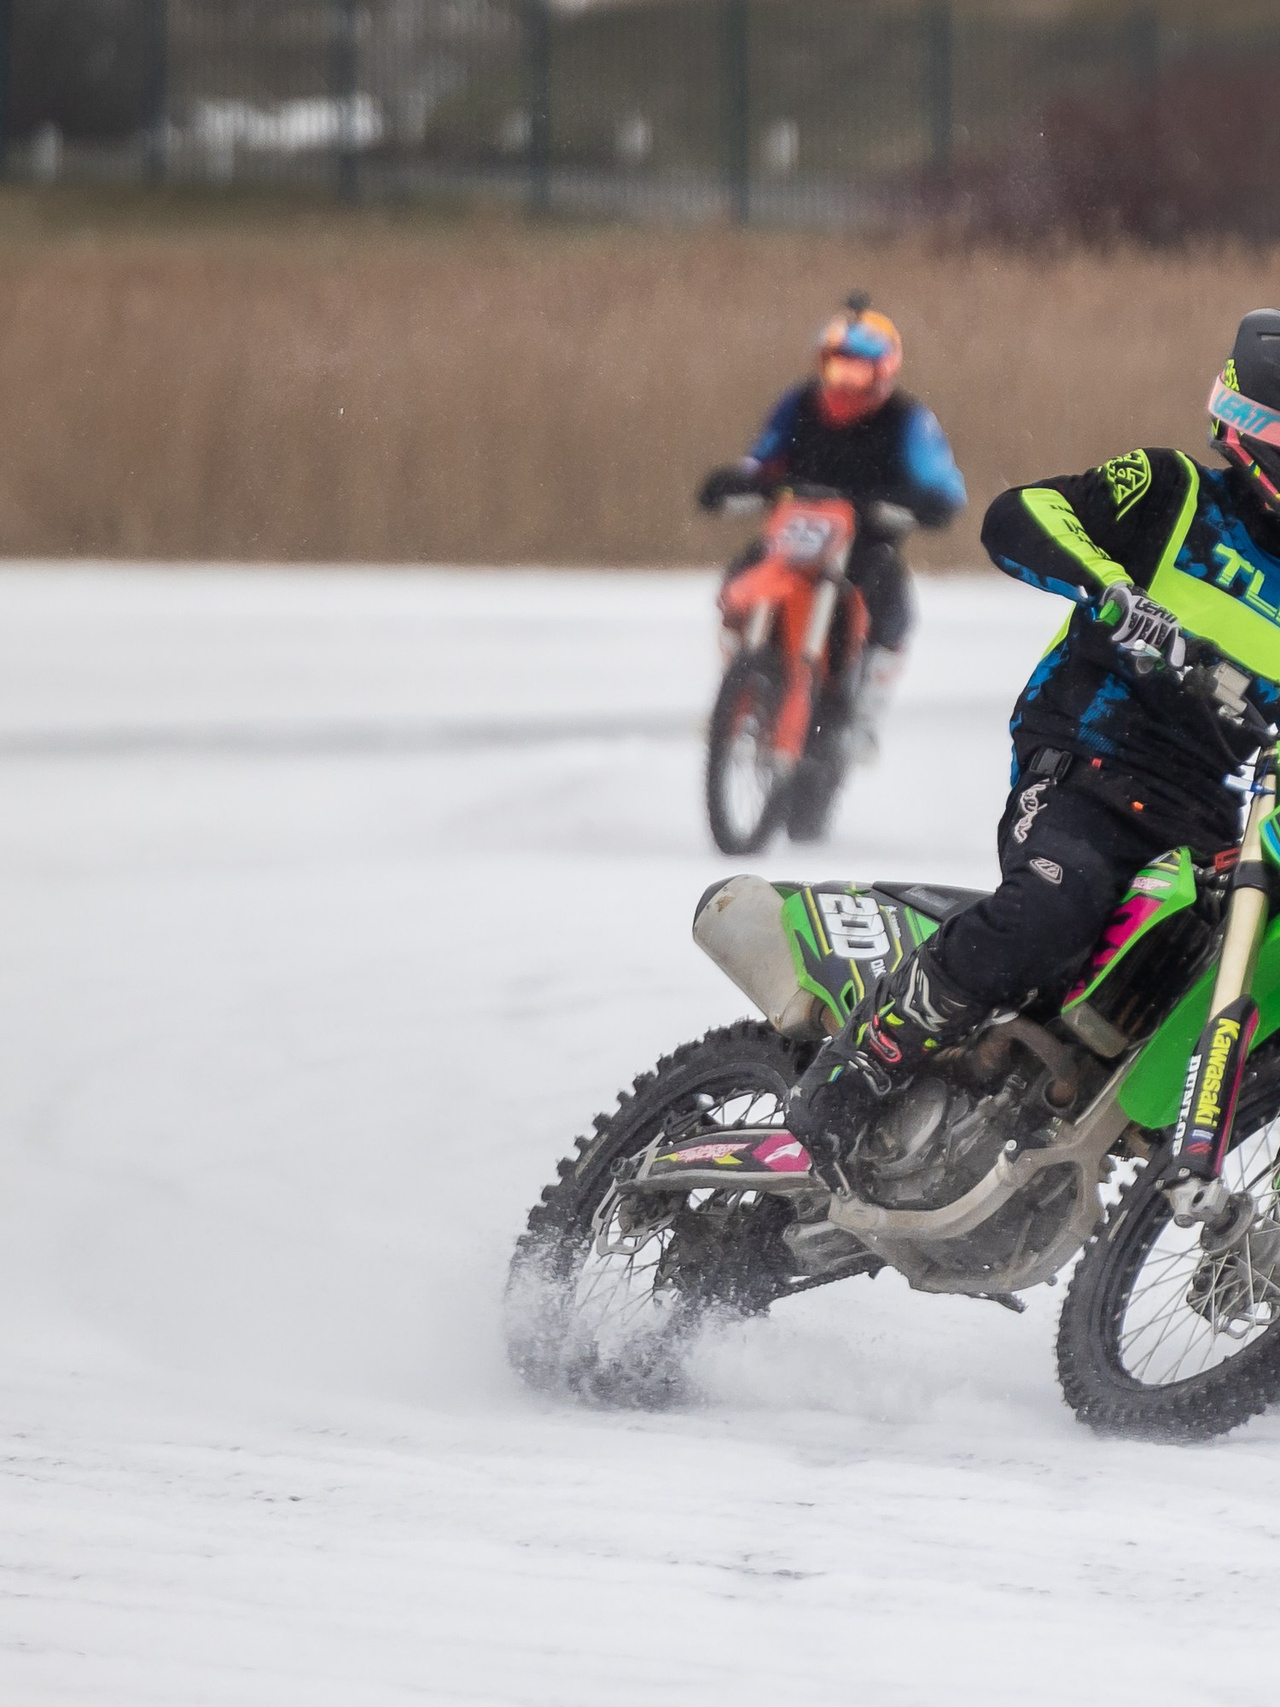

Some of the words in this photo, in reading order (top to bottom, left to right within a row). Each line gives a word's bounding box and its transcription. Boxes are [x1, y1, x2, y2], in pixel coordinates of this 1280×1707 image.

[818, 893, 891, 958] 200
[1172, 1054, 1202, 1157] DUNLOP
[1195, 1018, 1241, 1128] Kawasaki
